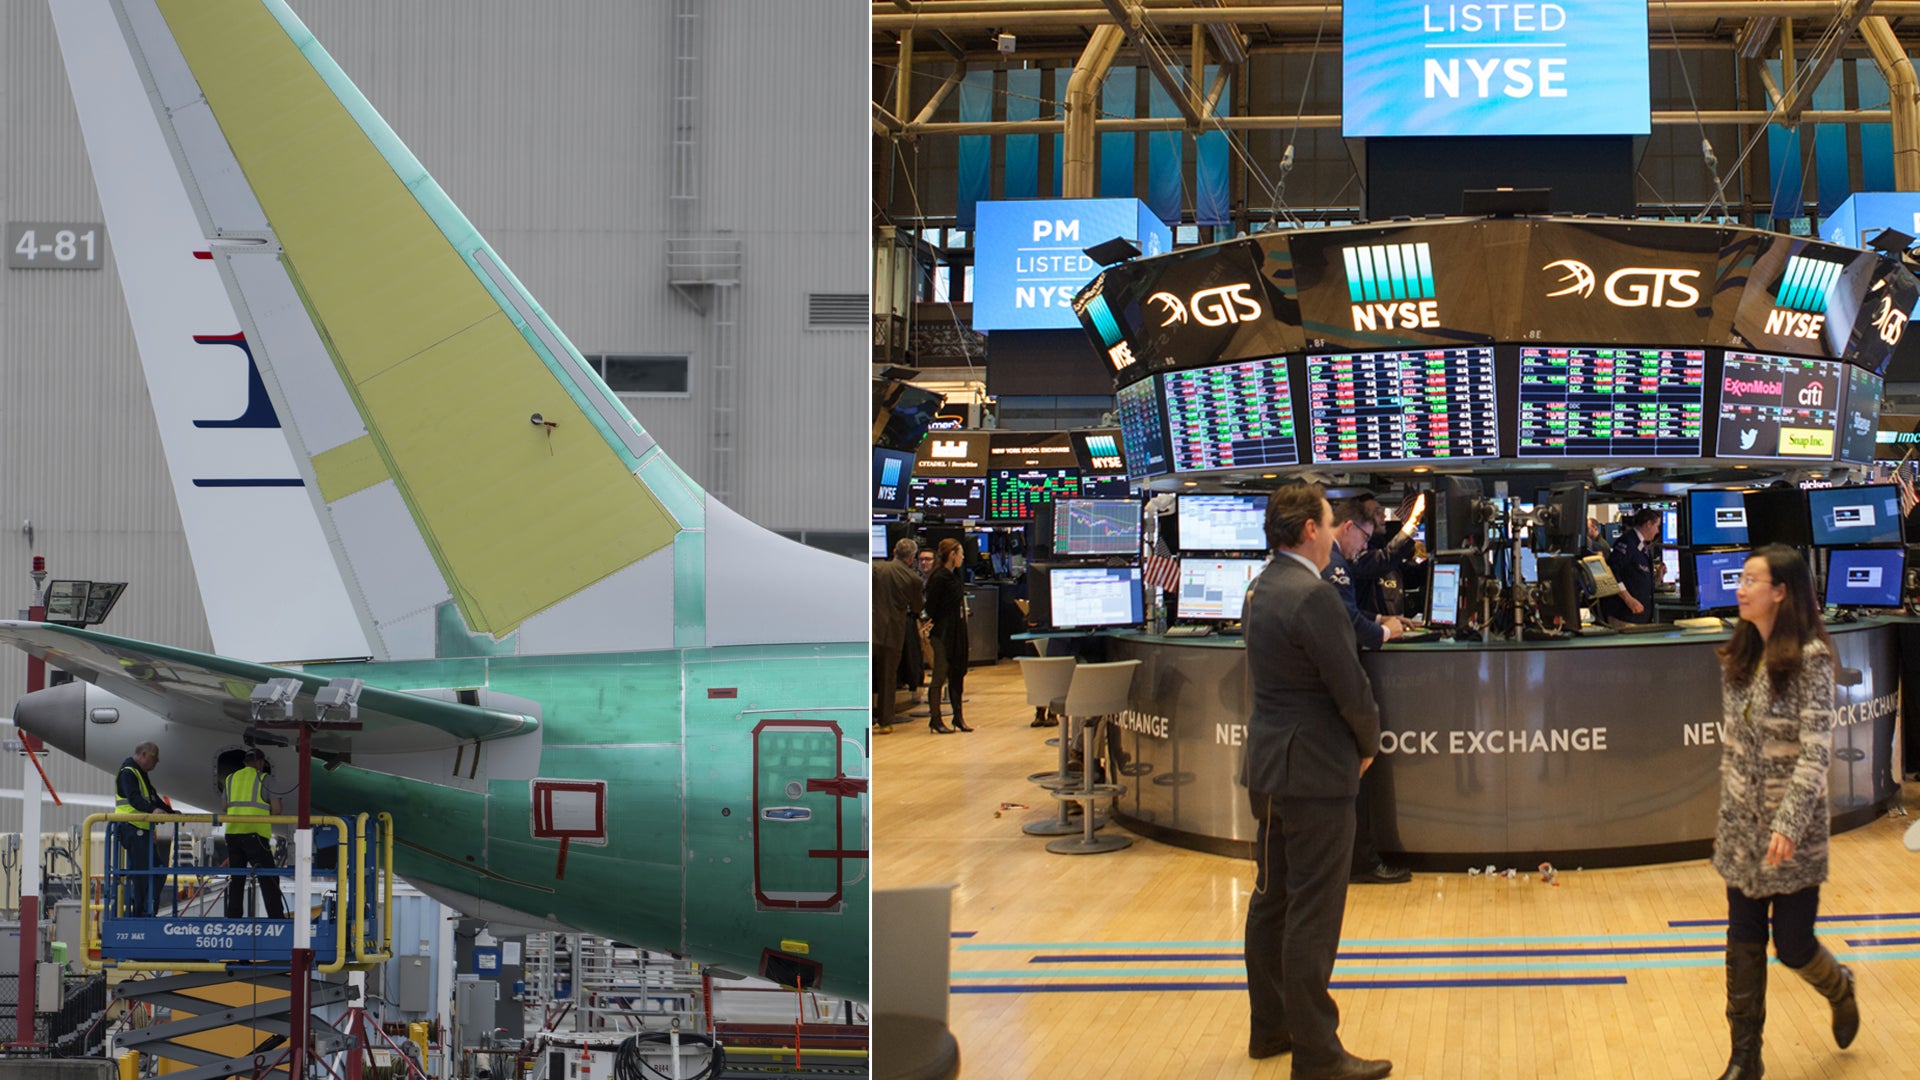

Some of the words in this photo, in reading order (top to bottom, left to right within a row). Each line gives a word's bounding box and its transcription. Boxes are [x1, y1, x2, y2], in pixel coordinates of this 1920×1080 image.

[1424, 4, 1567, 32] LISTED
[1424, 58, 1568, 98] NYSE
[1033, 219, 1080, 242] PM
[15, 230, 95, 261] 4-81
[1016, 255, 1093, 273] LISTED
[1016, 286, 1083, 309] NYS
[1604, 267, 1701, 308] GTS
[1190, 283, 1262, 327] GTS
[1351, 301, 1440, 332] NYSE
[1764, 309, 1825, 339] NYSE
[1724, 377, 1783, 397] ExxonMobil
[1798, 384, 1824, 406] citi
[1789, 433, 1809, 448] Snap
[1810, 435, 1824, 446] Inc.
[1091, 457, 1123, 469] NYSE
[878, 486, 897, 500] NYSE
[1379, 730, 1439, 754] OCK
[1449, 727, 1608, 754] EXCHANGE
[163, 923, 200, 935] Genie
[203, 923, 262, 936] GS-2646
[264, 924, 285, 937] AV
[195, 937, 233, 948] 56010
